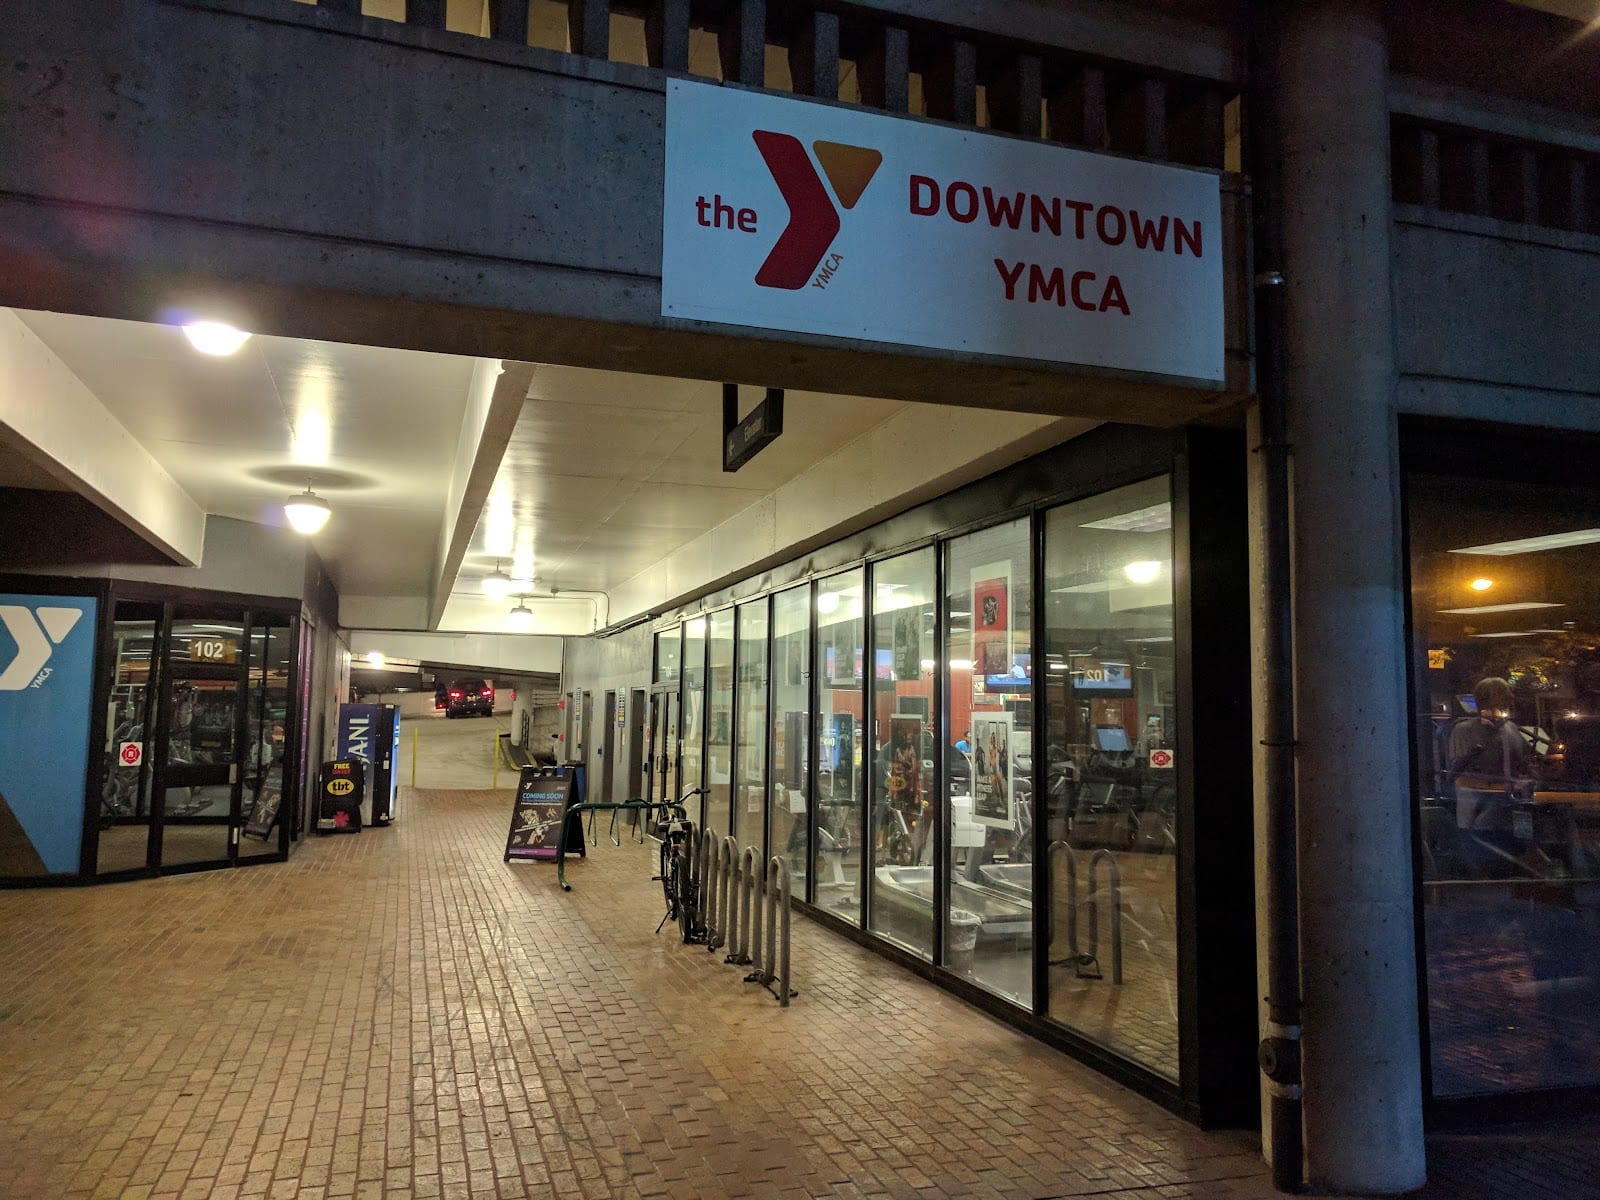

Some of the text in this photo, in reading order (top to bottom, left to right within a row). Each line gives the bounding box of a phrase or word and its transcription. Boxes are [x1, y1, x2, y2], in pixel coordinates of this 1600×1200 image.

[696, 195, 757, 233] the
[911, 176, 1202, 257] DOWNTOWN
[812, 253, 844, 289] YMCA
[994, 258, 1130, 316] YMCA
[195, 641, 223, 658] 102
[30, 668, 53, 688] YMCA
[332, 782, 349, 790] tbt
